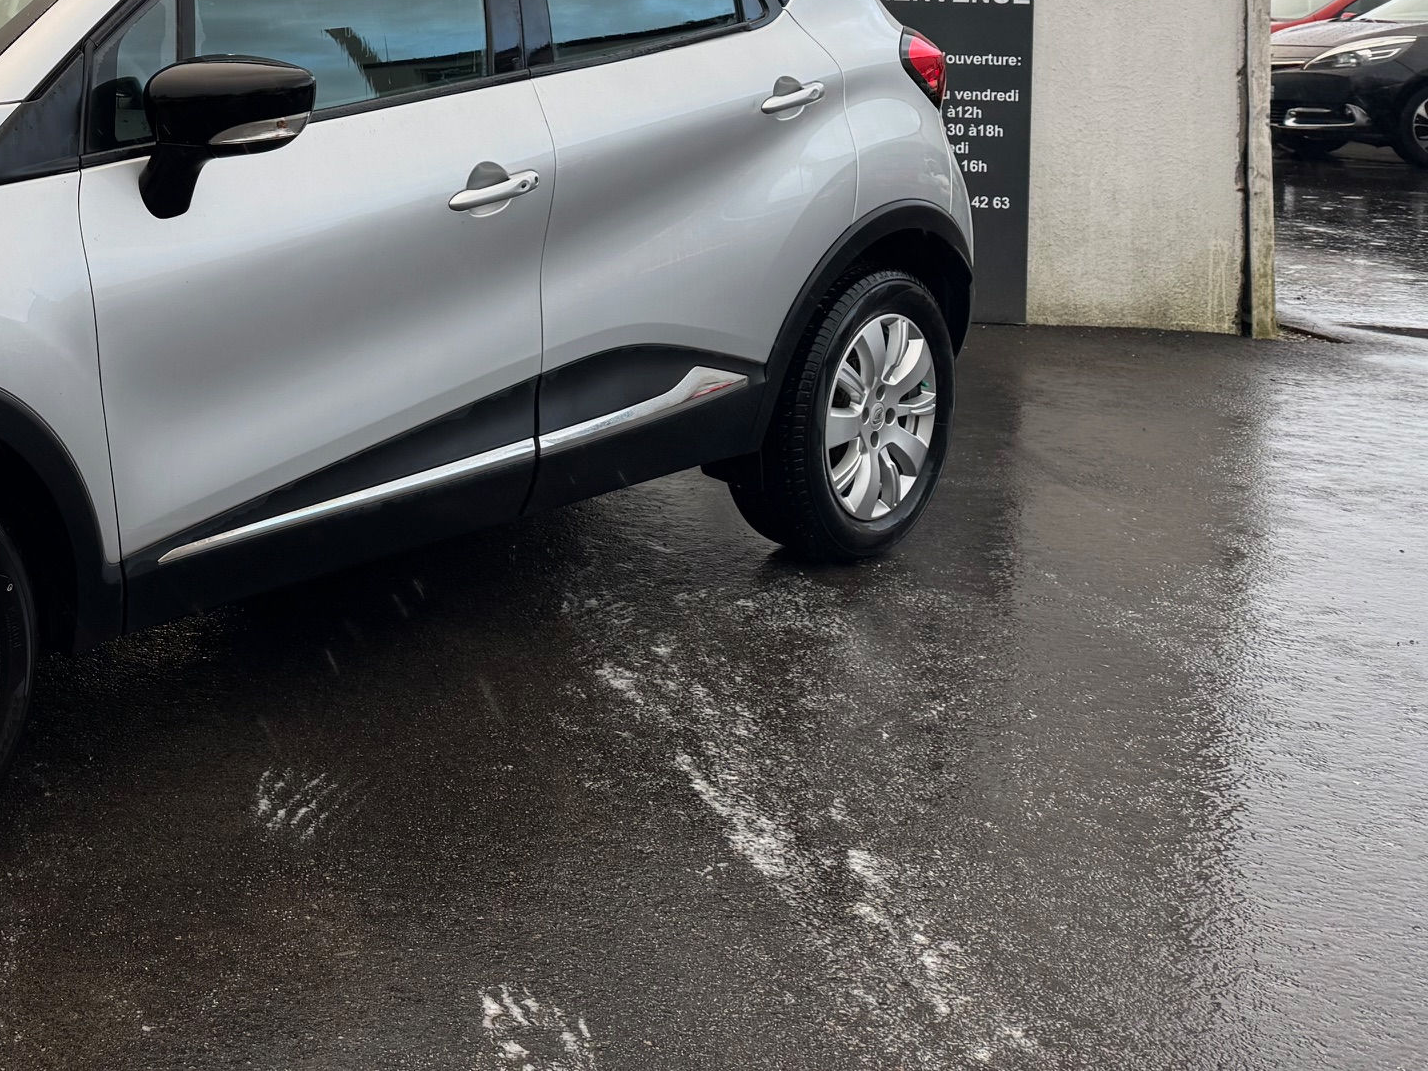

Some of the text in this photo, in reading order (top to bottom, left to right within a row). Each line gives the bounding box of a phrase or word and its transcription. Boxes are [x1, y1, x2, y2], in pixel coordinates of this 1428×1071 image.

[955, 89, 1019, 102] vendredi
[947, 105, 982, 119] à12h
[968, 123, 1004, 137] à18h
[961, 159, 988, 173] 16h
[971, 195, 1011, 209] 42 63
